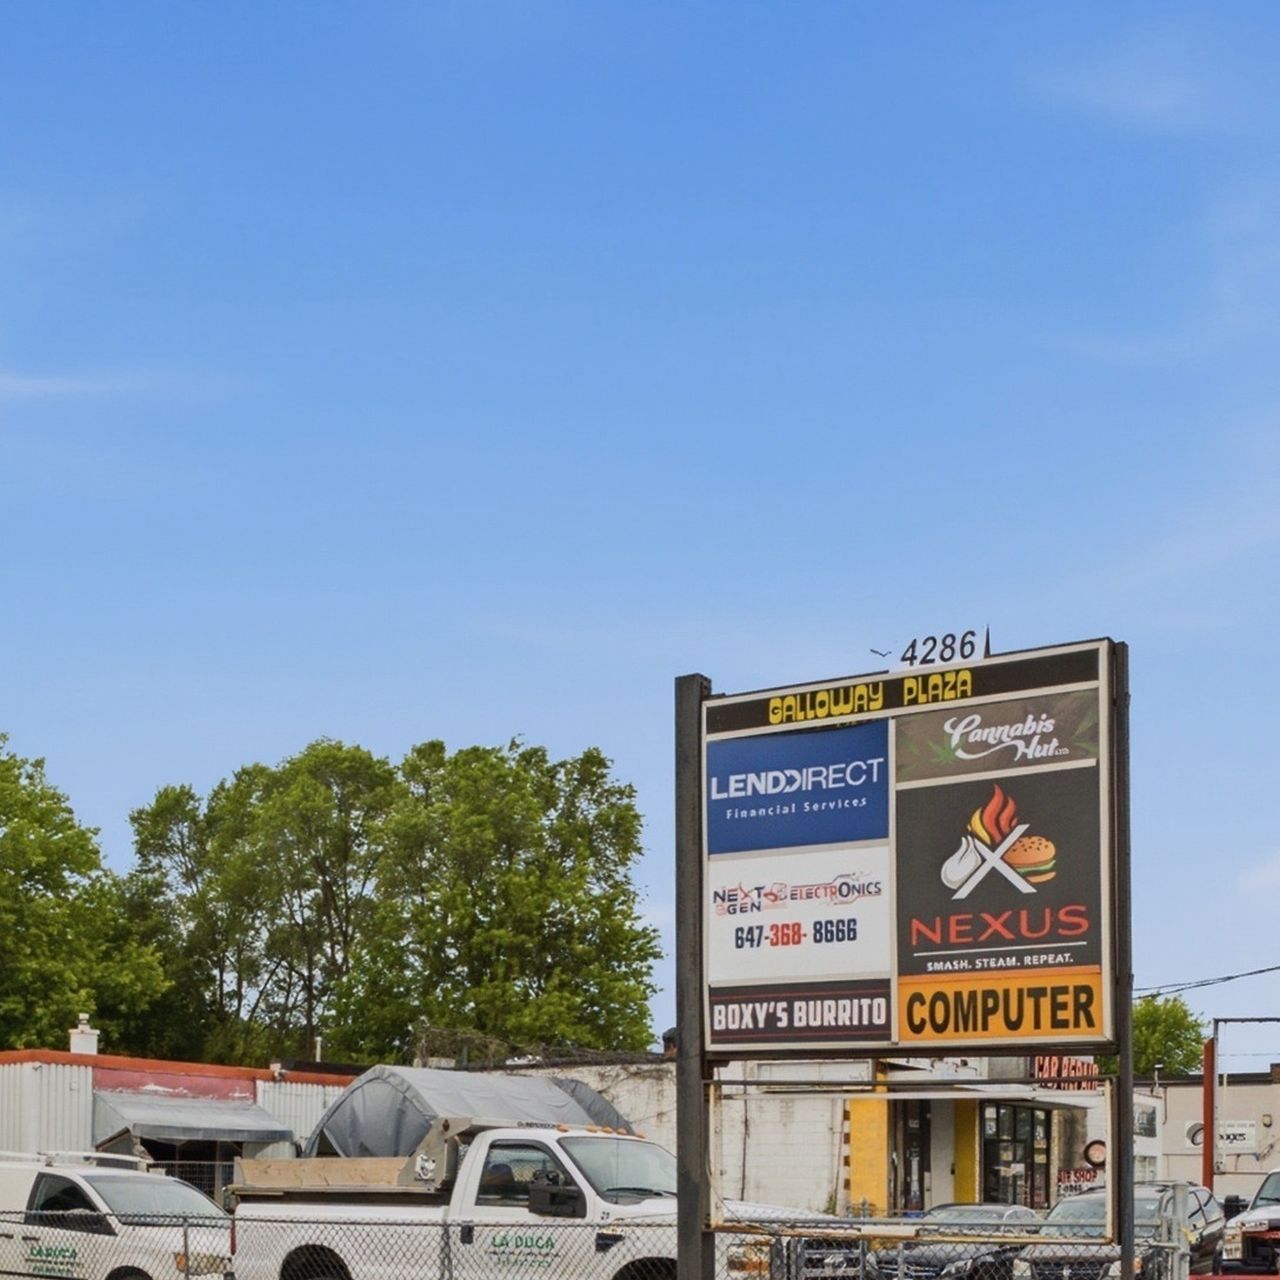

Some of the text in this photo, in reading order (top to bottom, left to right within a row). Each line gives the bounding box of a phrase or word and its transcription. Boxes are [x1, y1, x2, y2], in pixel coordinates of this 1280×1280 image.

[901, 630, 976, 666] 4286
[769, 669, 972, 724] GALLOWAY PLAZA
[943, 713, 1055, 749] Cannabis
[726, 797, 867, 819] Financial Services
[790, 882, 882, 901] ELECTRONICS
[727, 901, 761, 916] GEN
[813, 918, 857, 943] 8666
[911, 905, 1090, 946] NEXUS
[926, 953, 1074, 972] SMASH. STEAM. REPEAT.
[713, 998, 886, 1030] BOXY'S BURRITO
[907, 984, 1096, 1034] COMPUTER
[514, 1235, 555, 1249] DUCA
